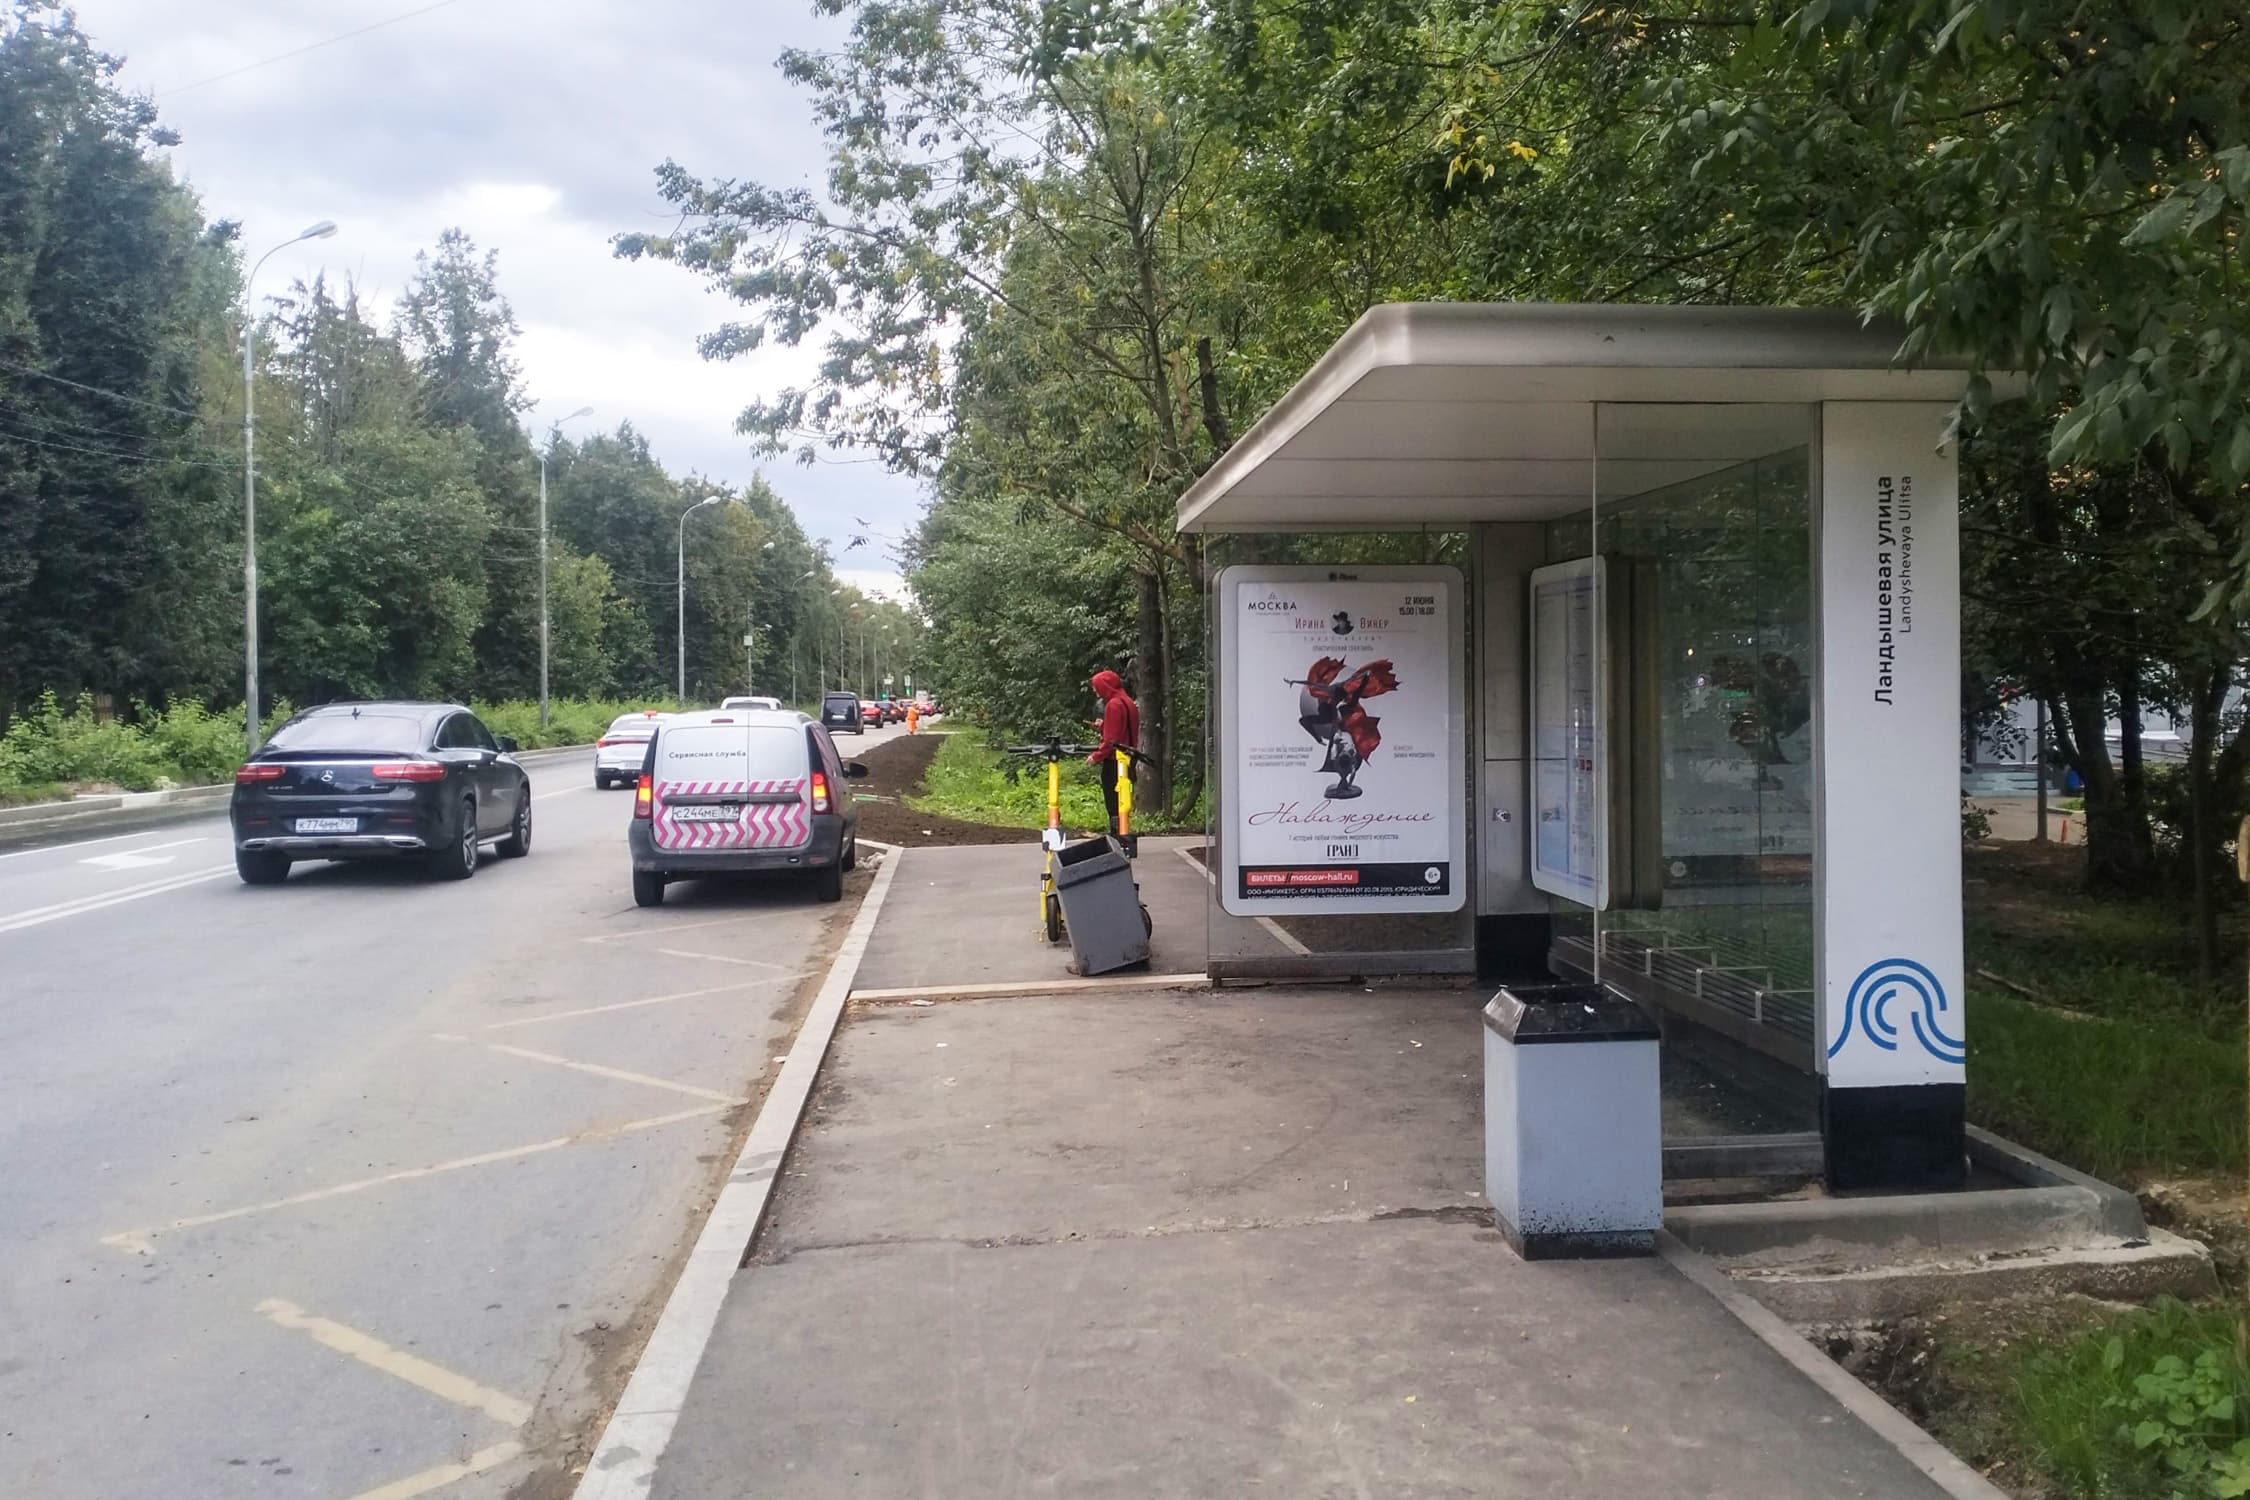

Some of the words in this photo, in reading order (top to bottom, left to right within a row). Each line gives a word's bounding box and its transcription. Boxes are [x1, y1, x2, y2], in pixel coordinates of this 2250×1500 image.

[1878, 476, 1897, 545] улица
[1899, 476, 1912, 520] Ulitsa
[1898, 527, 1914, 633] Landyshevaya
[1248, 601, 1297, 610] МОСКВА
[1875, 552, 1896, 705] Ландышевая
[715, 750, 746, 758] служба
[1248, 799, 1436, 834] Наваждение
